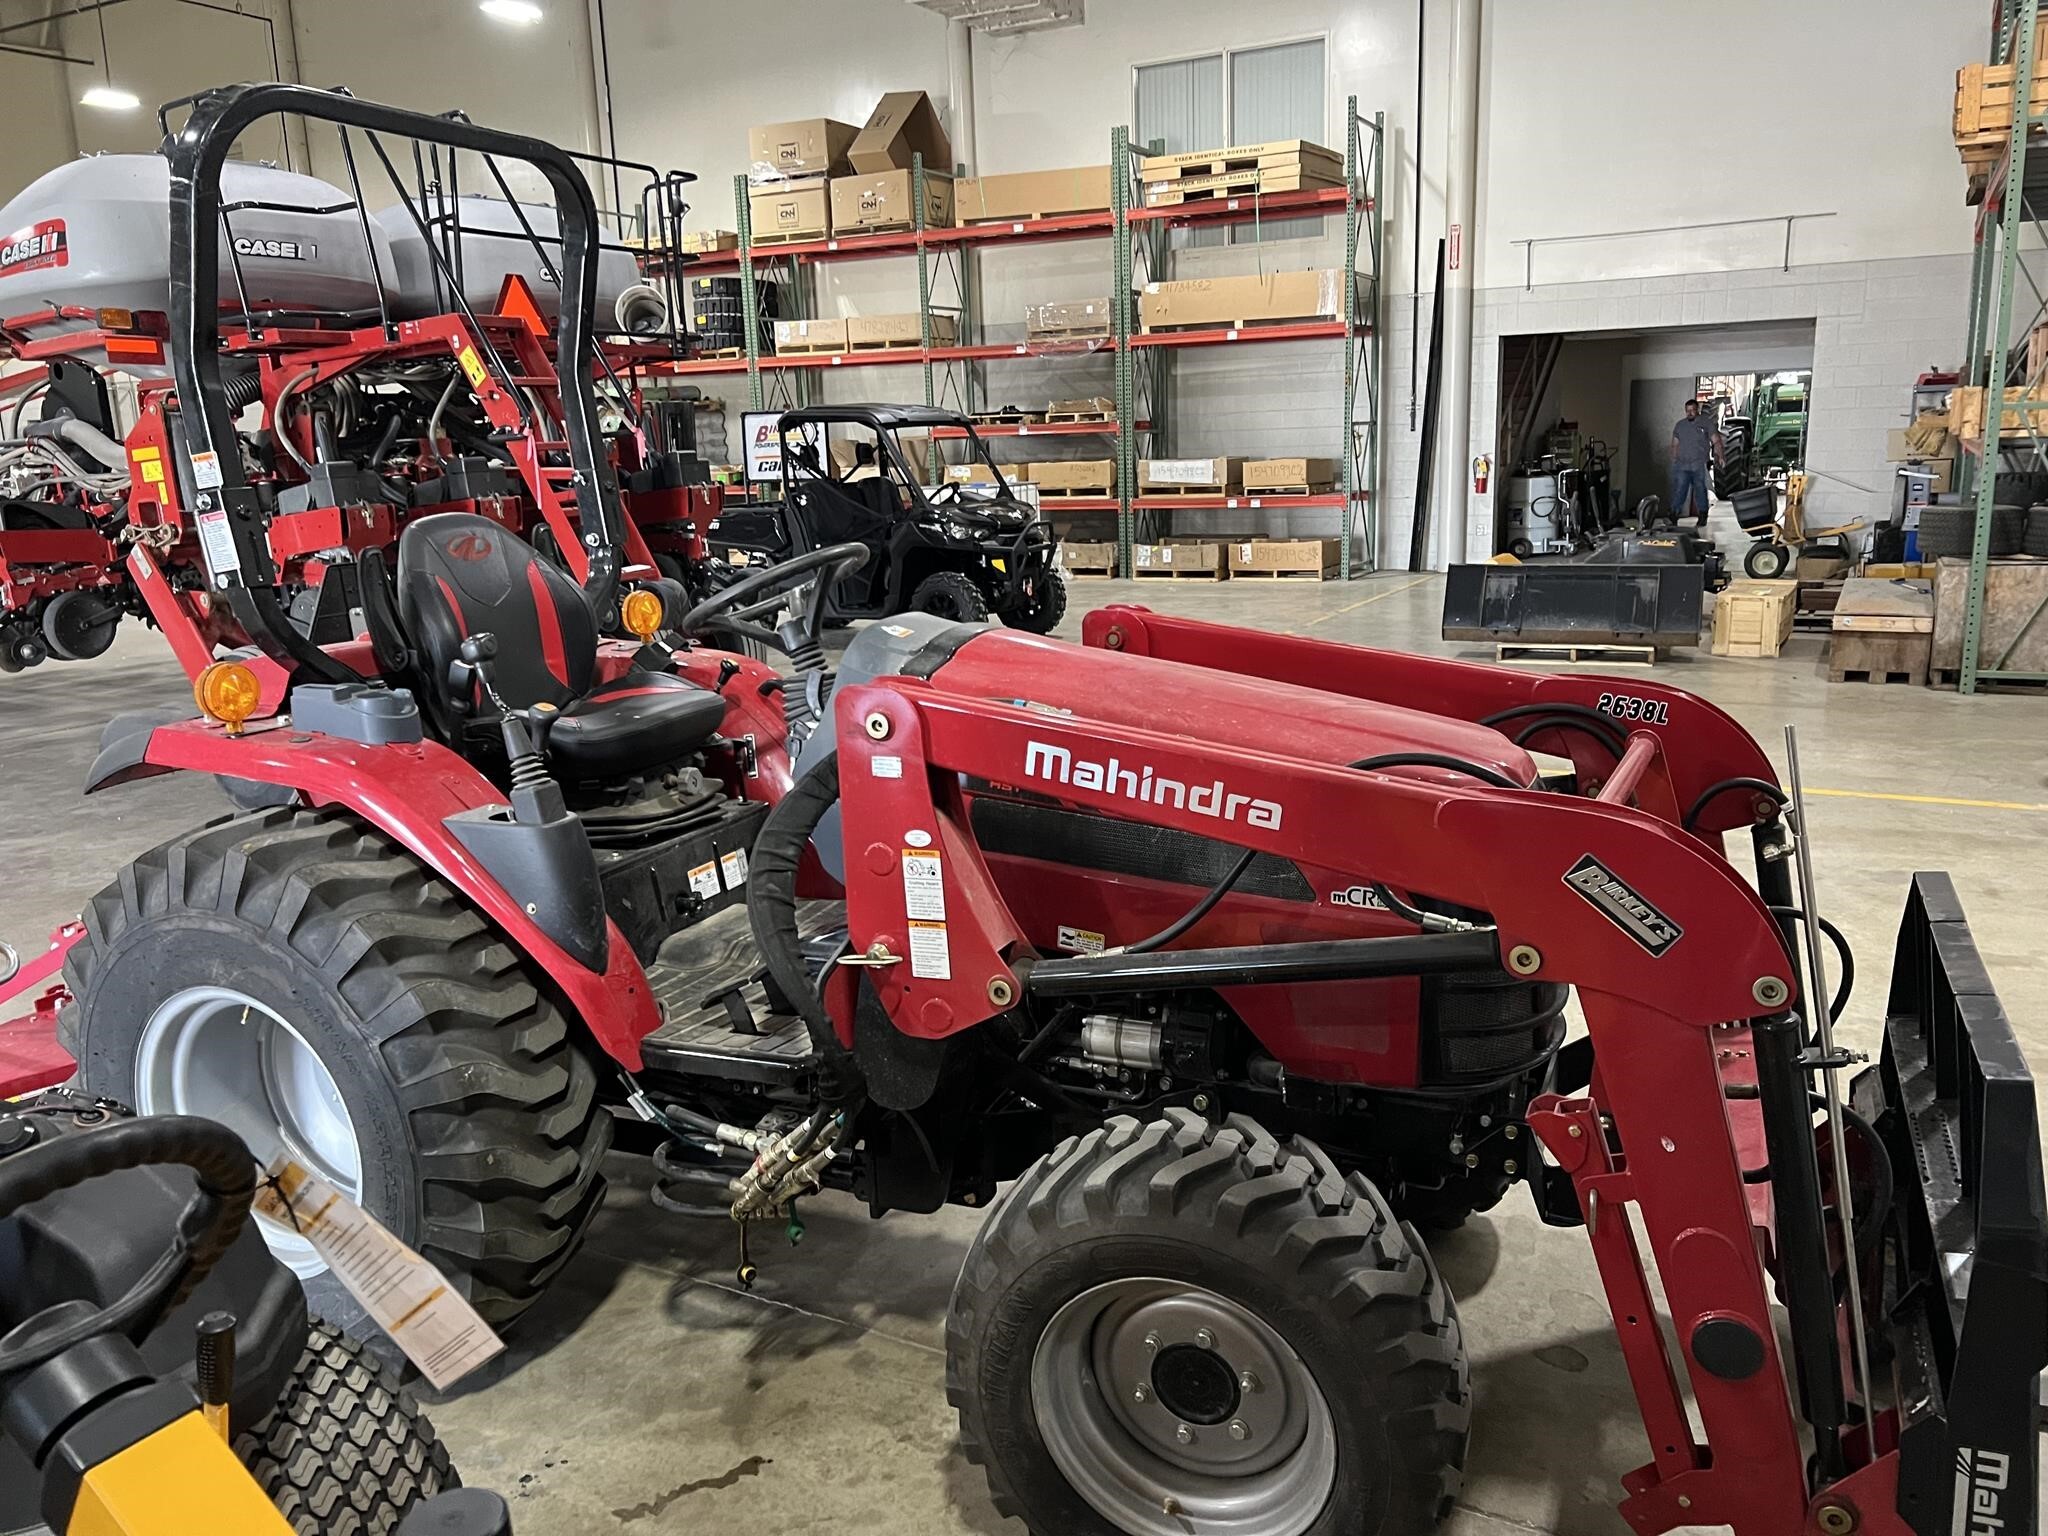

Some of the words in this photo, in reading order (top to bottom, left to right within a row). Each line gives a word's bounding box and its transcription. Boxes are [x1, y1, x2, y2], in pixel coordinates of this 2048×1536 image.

[1173, 154, 1193, 163] STACK
[1194, 151, 1225, 161] IDENTICAL
[1226, 148, 1248, 156] BOXES
[1228, 173, 1249, 181] BOXES
[1, 236, 41, 266] CASE
[233, 237, 297, 259] CASE
[1596, 692, 1669, 726] 2638L
[1024, 740, 1283, 831] Mahindra
